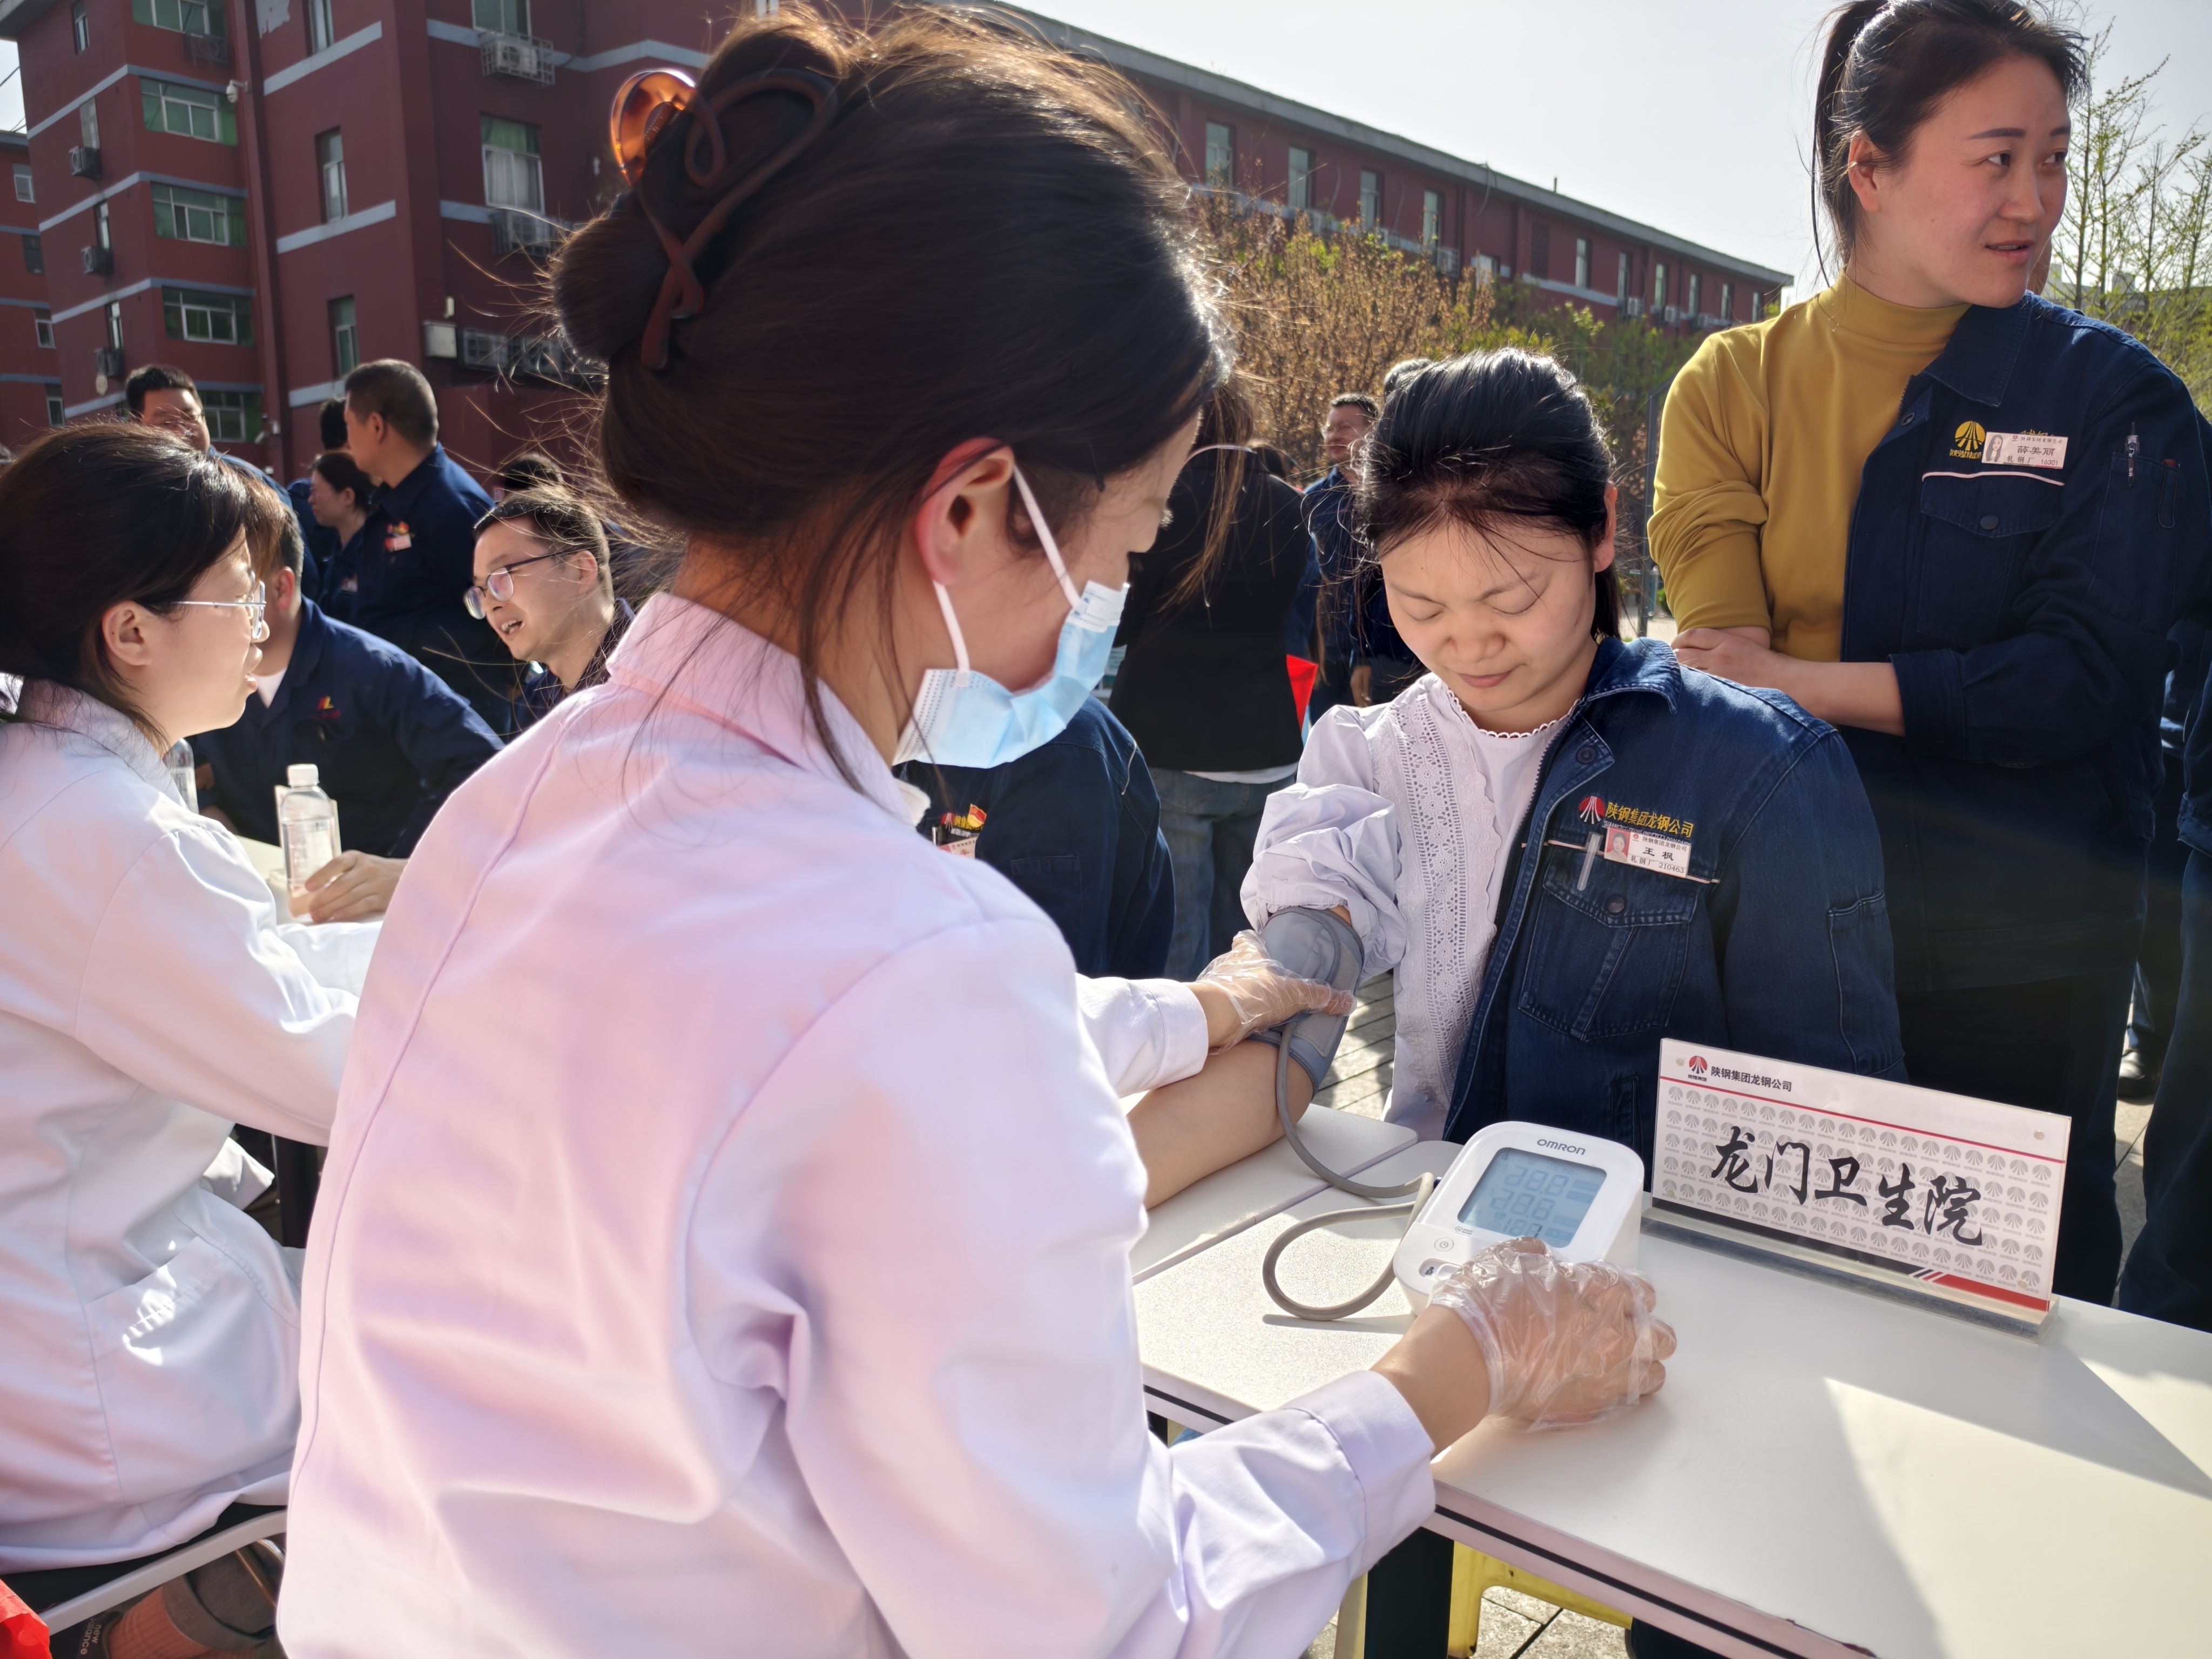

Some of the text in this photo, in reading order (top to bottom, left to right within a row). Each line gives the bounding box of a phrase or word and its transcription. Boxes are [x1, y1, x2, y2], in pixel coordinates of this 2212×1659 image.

[2007, 455, 2035, 463] 轧钢厂
[2017, 446, 2055, 456] 薛美丽
[1606, 802, 1694, 838] 陕钢集团龙钢公司
[1642, 836, 1687, 852] 陕钢集团龙钢公司
[1630, 855, 1684, 873] 轧钢厂 210463
[1711, 1066, 1792, 1091] 陕钢集团龙钢公司
[1537, 1139, 1586, 1155] OMRON
[1711, 1126, 1982, 1246] 龙门卫生院
[92, 1624, 102, 1643] new
